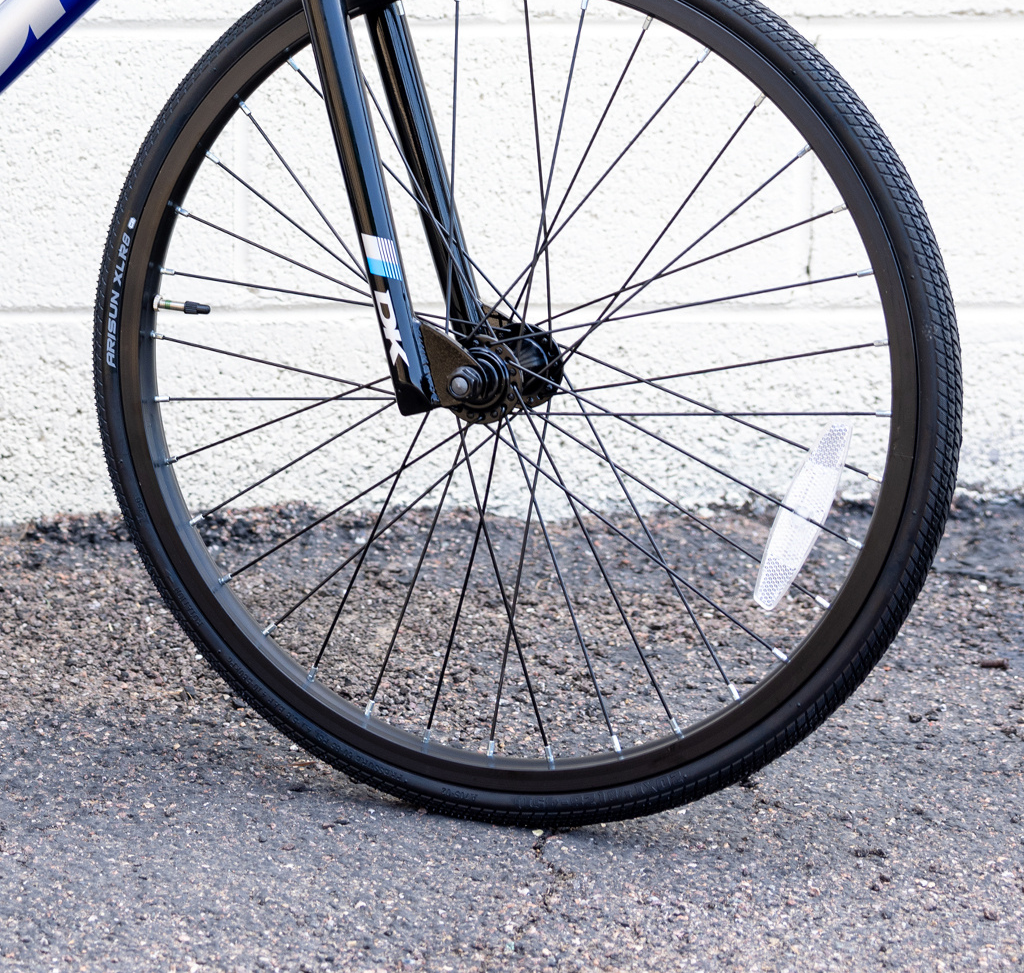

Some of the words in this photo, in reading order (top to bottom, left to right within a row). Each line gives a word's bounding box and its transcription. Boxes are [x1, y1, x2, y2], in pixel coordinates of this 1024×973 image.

[106, 290, 120, 368] ARISUN
[114, 233, 131, 287] XLR8
[374, 289, 410, 367] DK
[173, 586, 203, 628] ROTATION
